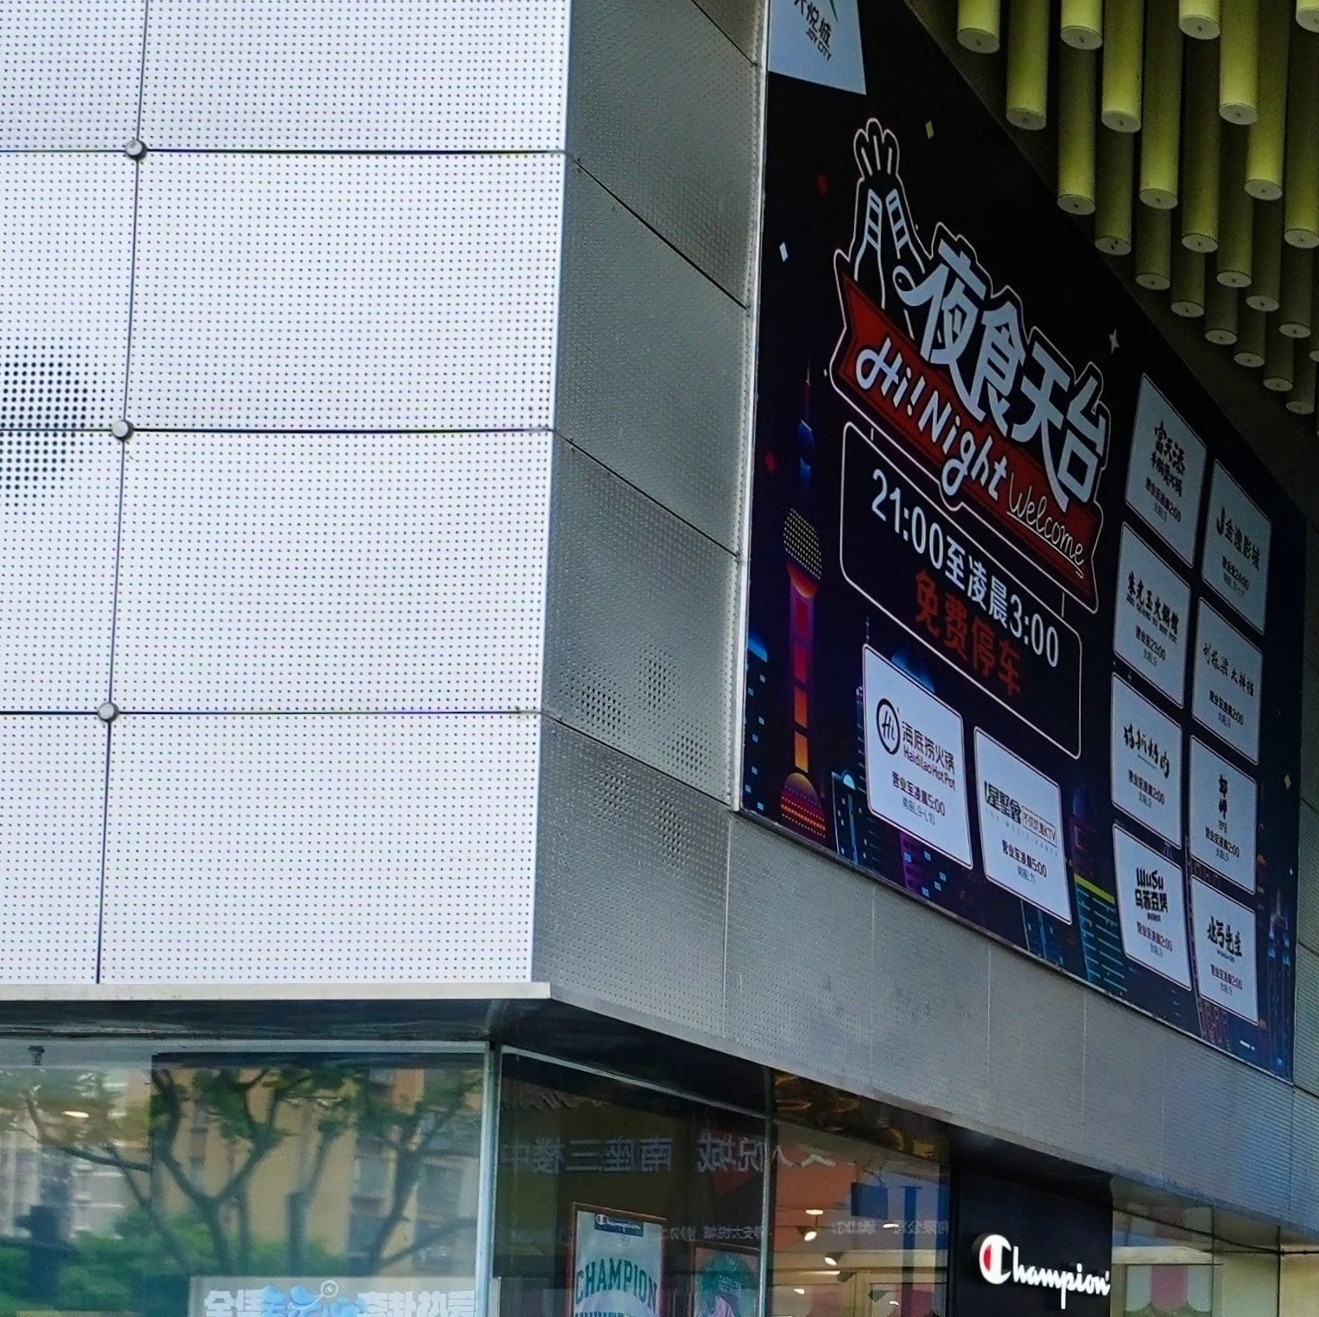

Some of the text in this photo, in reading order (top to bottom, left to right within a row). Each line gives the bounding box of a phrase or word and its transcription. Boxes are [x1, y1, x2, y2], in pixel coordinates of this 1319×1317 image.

[918, 390, 1010, 500] Night
[1009, 472, 1085, 567] Welcome
[871, 468, 1059, 668] 21:00至凌晨3:00
[914, 569, 1022, 698] 免费停车
[901, 719, 954, 775] 海底捞火锅
[576, 1258, 658, 1315] CHAMPION
[978, 1233, 1112, 1309] Champion
